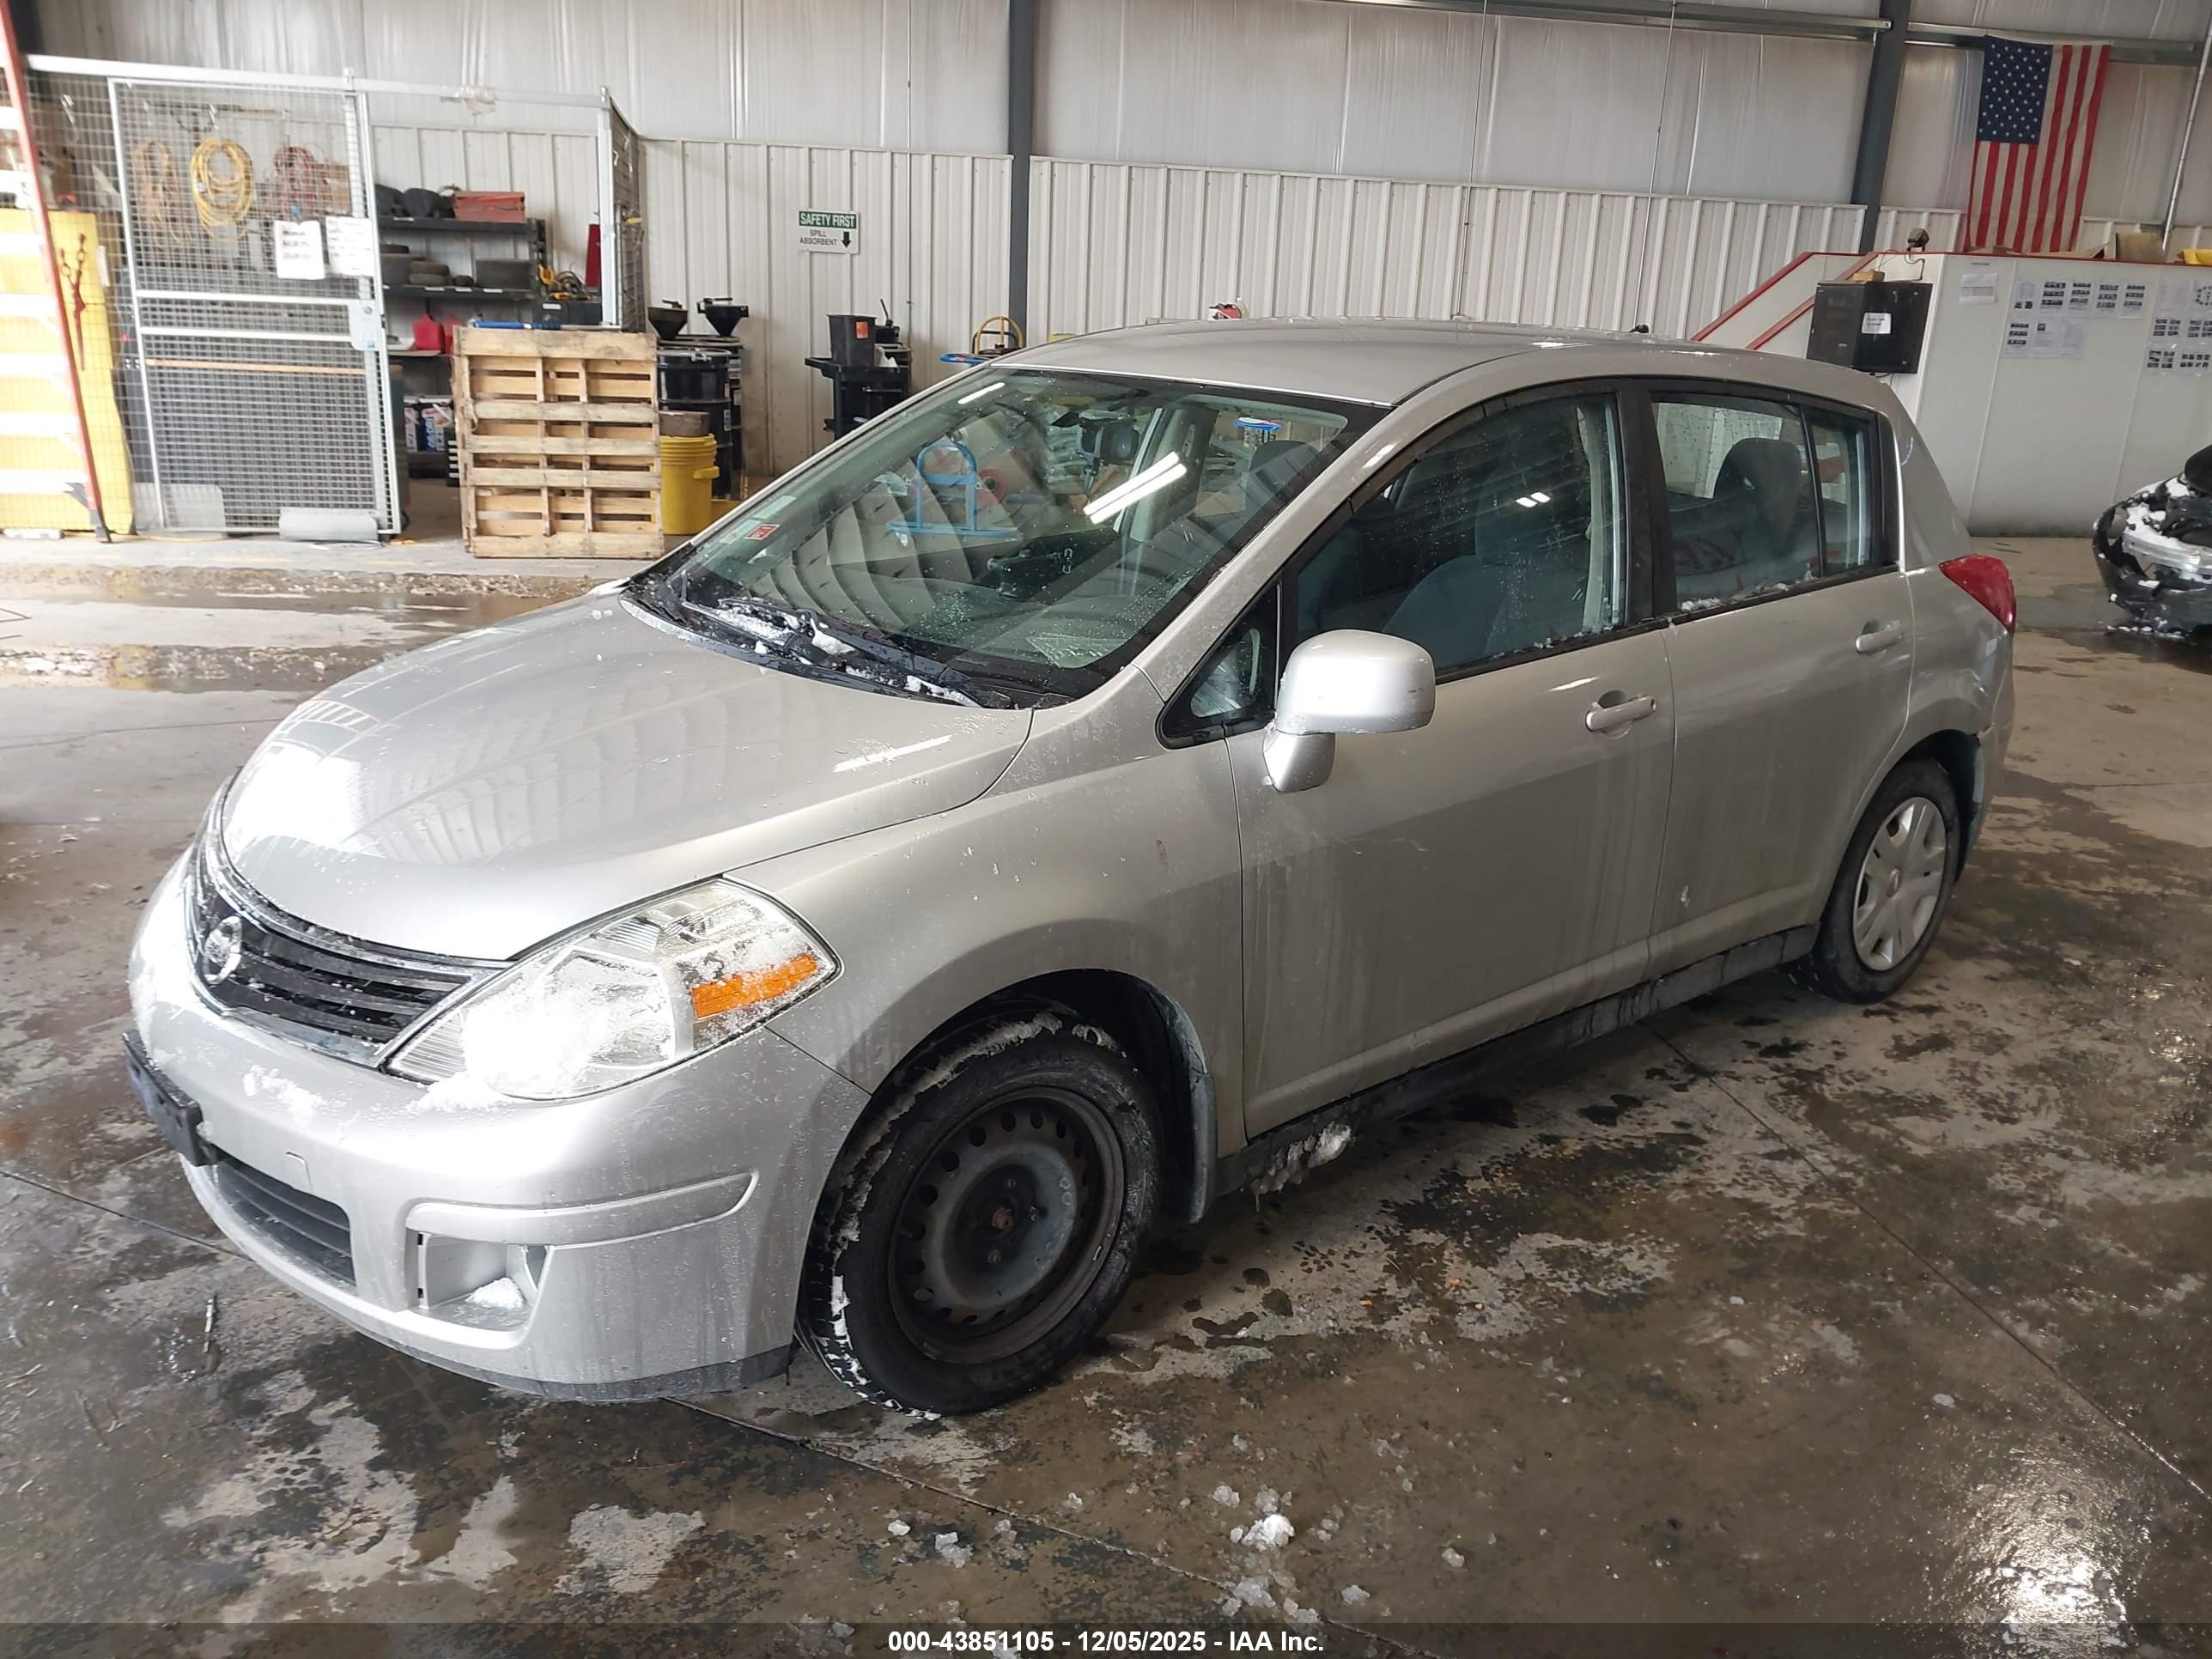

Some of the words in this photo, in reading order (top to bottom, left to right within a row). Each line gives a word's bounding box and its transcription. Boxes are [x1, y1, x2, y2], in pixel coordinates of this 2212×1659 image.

[800, 212, 830, 226] SAFETY
[832, 214, 855, 228] FIRST
[799, 237, 837, 246] ABSORBENT
